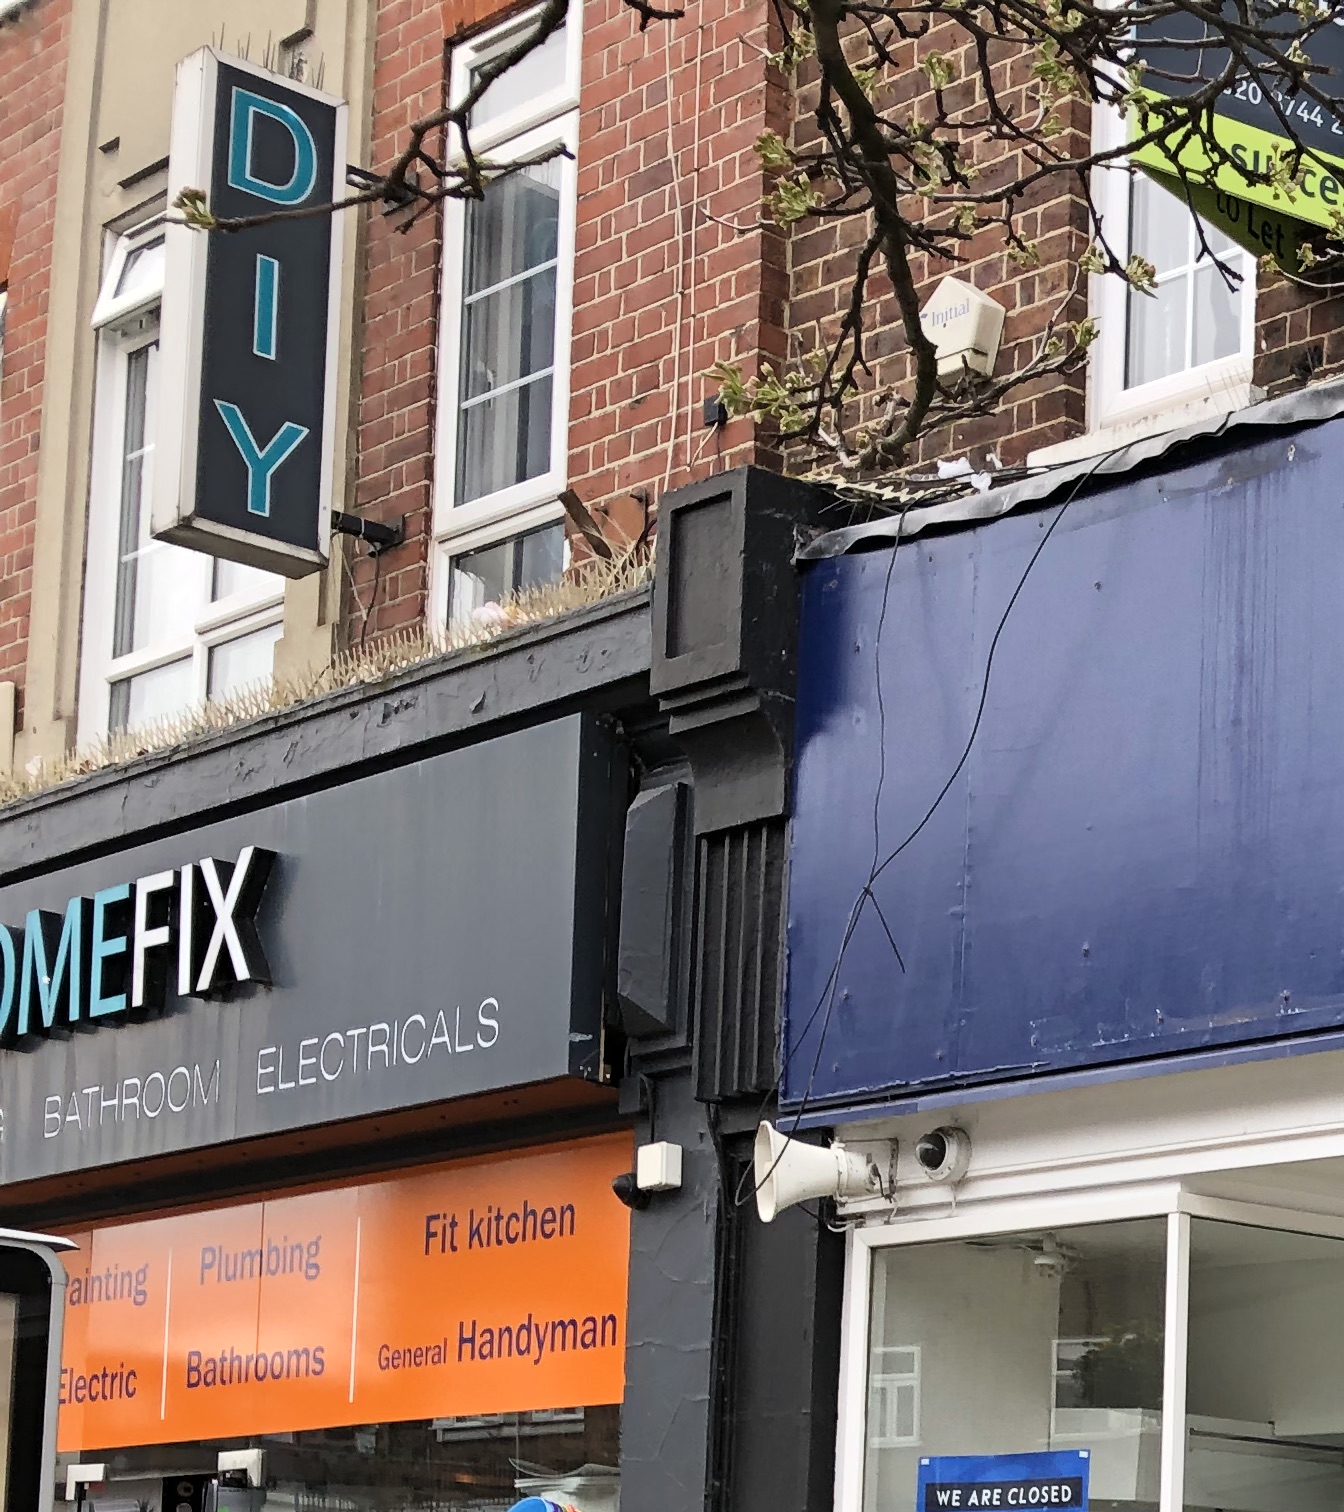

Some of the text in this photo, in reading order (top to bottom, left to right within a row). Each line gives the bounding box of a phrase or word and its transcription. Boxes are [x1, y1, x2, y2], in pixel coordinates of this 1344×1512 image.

[1247, 203, 1285, 259] Let
[213, 86, 318, 517] DIY
[932, 299, 970, 327] Initial
[0, 845, 254, 1036] MEFIX
[43, 1060, 220, 1139] BATHROOM
[256, 996, 500, 1095] ELECTRICALS
[424, 1200, 576, 1256] Fit kitchen
[200, 1234, 322, 1286] Plumbing
[186, 1343, 325, 1389] Bathrooms
[378, 1311, 618, 1371] General Handyman
[937, 1484, 1073, 1507] WE ARE CLOSED
